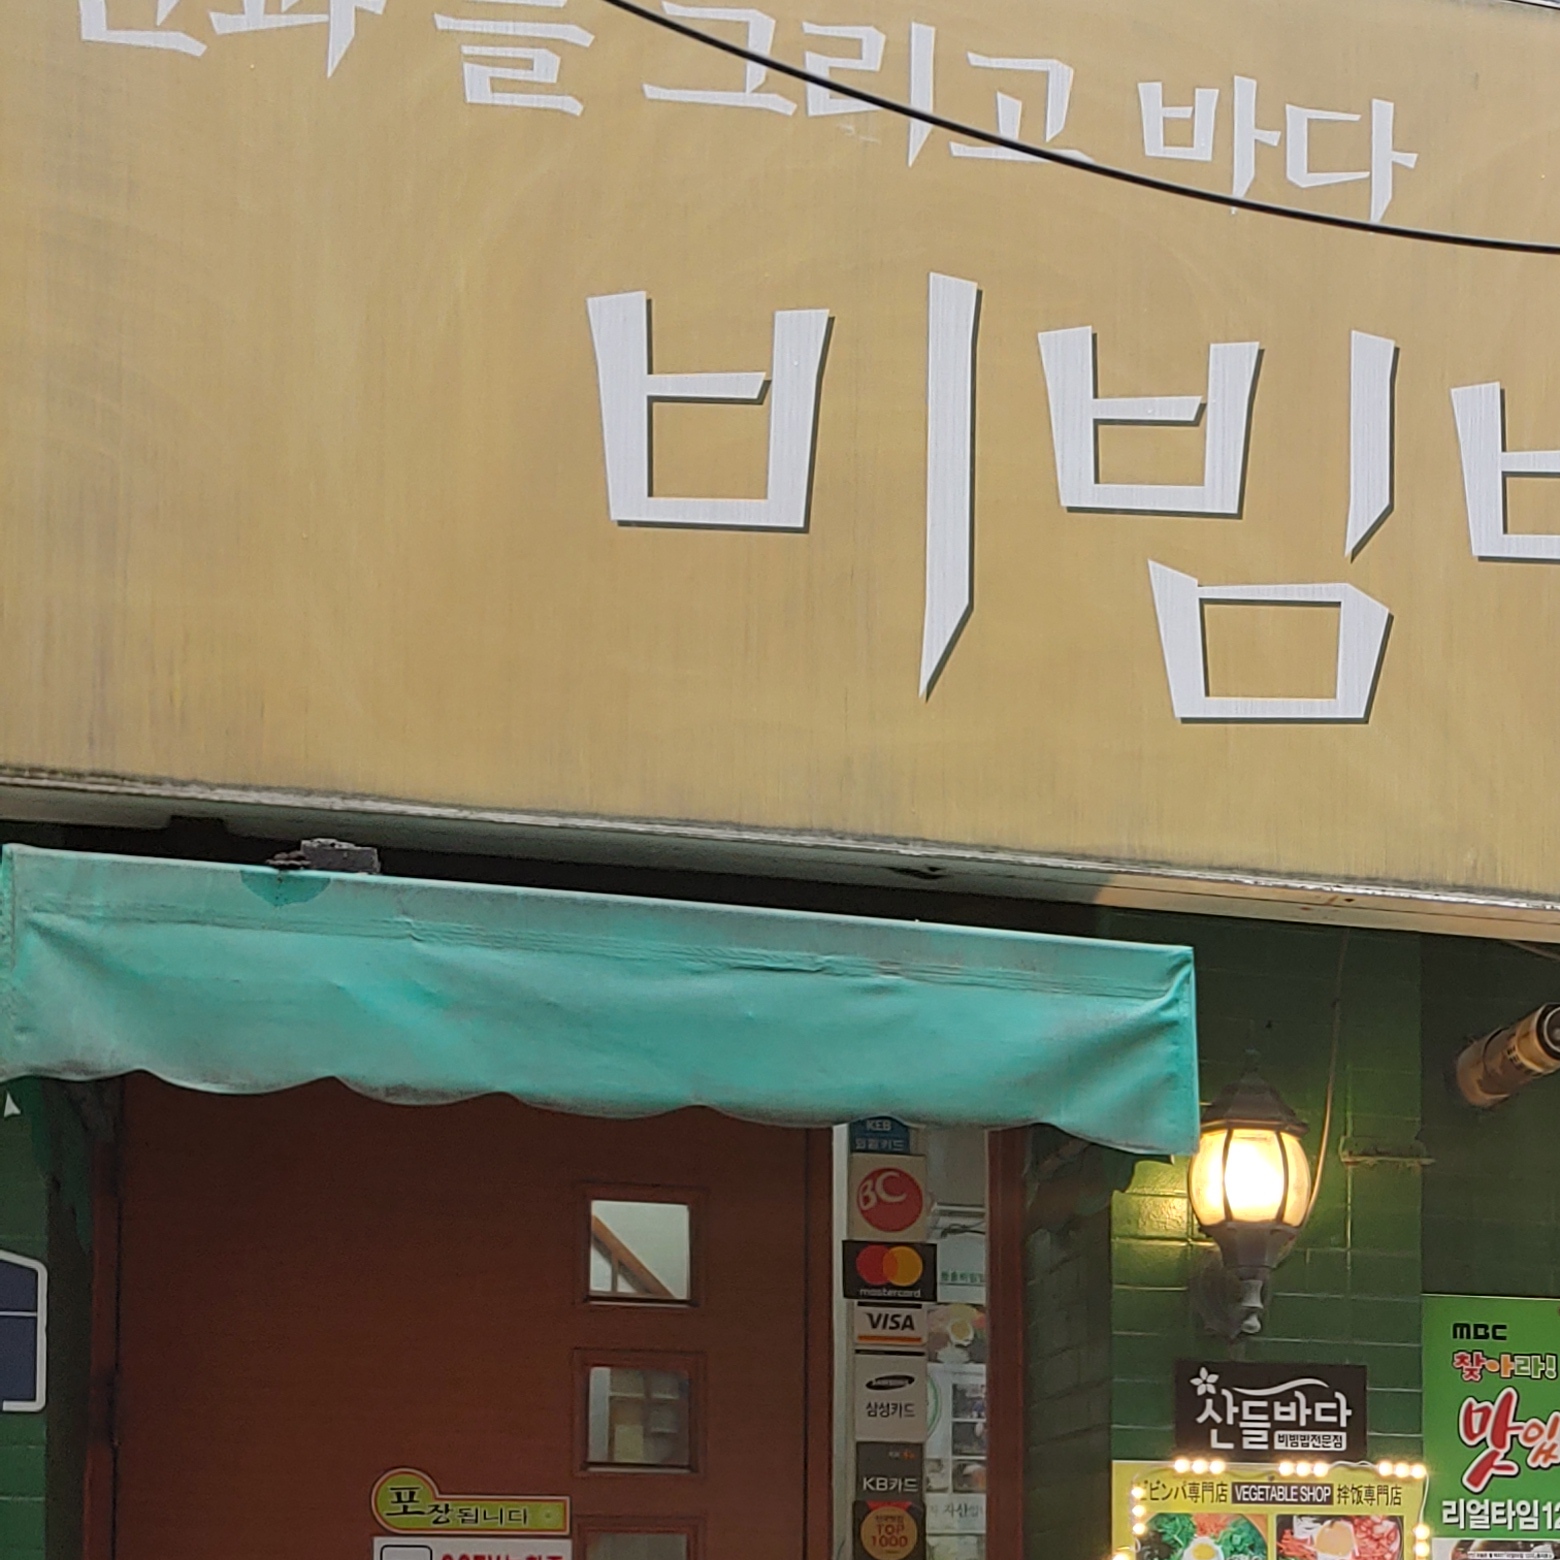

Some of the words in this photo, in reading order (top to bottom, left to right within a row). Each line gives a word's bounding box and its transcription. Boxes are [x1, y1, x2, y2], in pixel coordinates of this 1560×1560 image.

[642, 0, 1098, 168] 그리고
[1138, 75, 1418, 224] 바다
[866, 1119, 892, 1131] KEB
[859, 1171, 908, 1210] BC
[859, 1288, 921, 1299] mastercard
[867, 1313, 915, 1331] VISA
[1452, 1322, 1508, 1341] MBC
[1453, 1350, 1558, 1382] 찾아라!
[865, 1403, 916, 1418] 삼성카드
[1196, 1388, 1353, 1450] 산들바다
[1277, 1433, 1343, 1450] 비빔밥전문점
[862, 1477, 919, 1492] KB카드
[1234, 1486, 1300, 1503] VEGETABLE
[1299, 1488, 1332, 1504] SHOP
[385, 1486, 528, 1525] 포장됩니다
[876, 1524, 906, 1536] TOP
[870, 1535, 908, 1548] 1000
